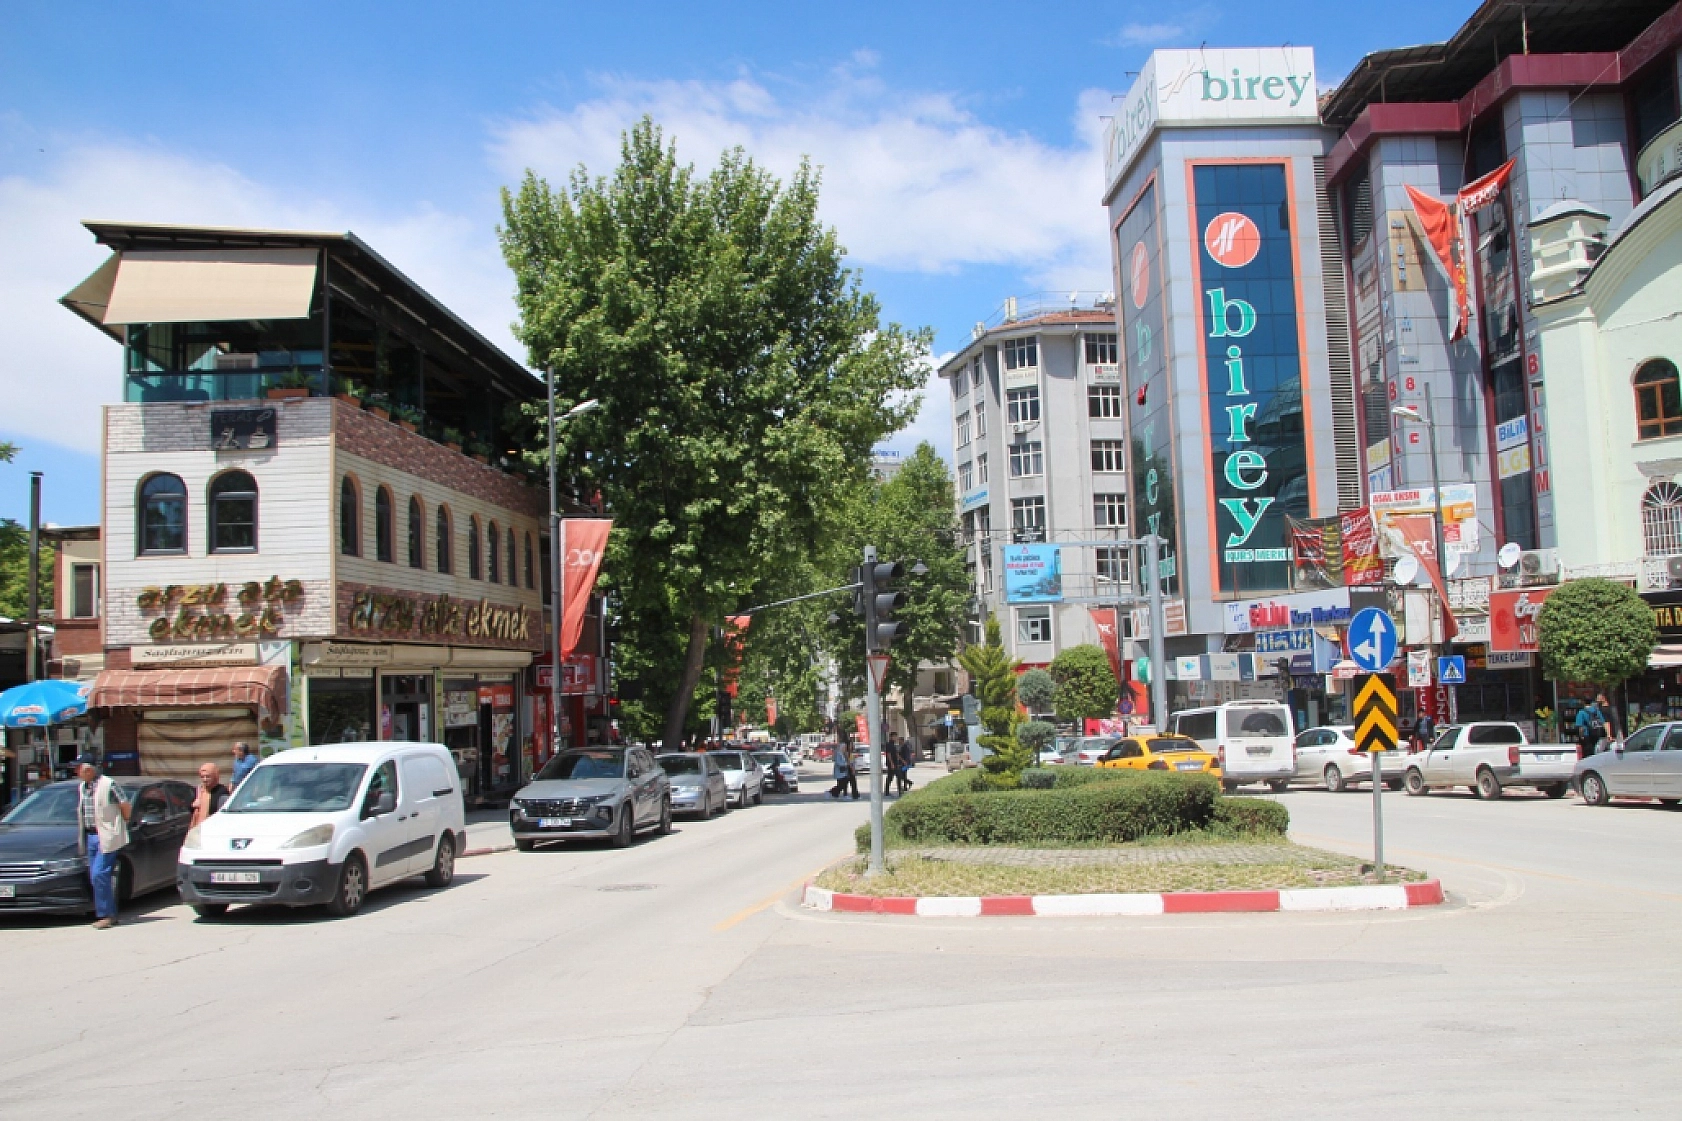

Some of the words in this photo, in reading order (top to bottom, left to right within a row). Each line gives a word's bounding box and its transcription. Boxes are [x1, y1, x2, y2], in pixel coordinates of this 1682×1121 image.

[1201, 68, 1311, 107] birey
[1116, 75, 1154, 162] birey
[1206, 288, 1276, 548] birey
[150, 606, 284, 638] ekmek
[466, 598, 529, 641] ekmek
